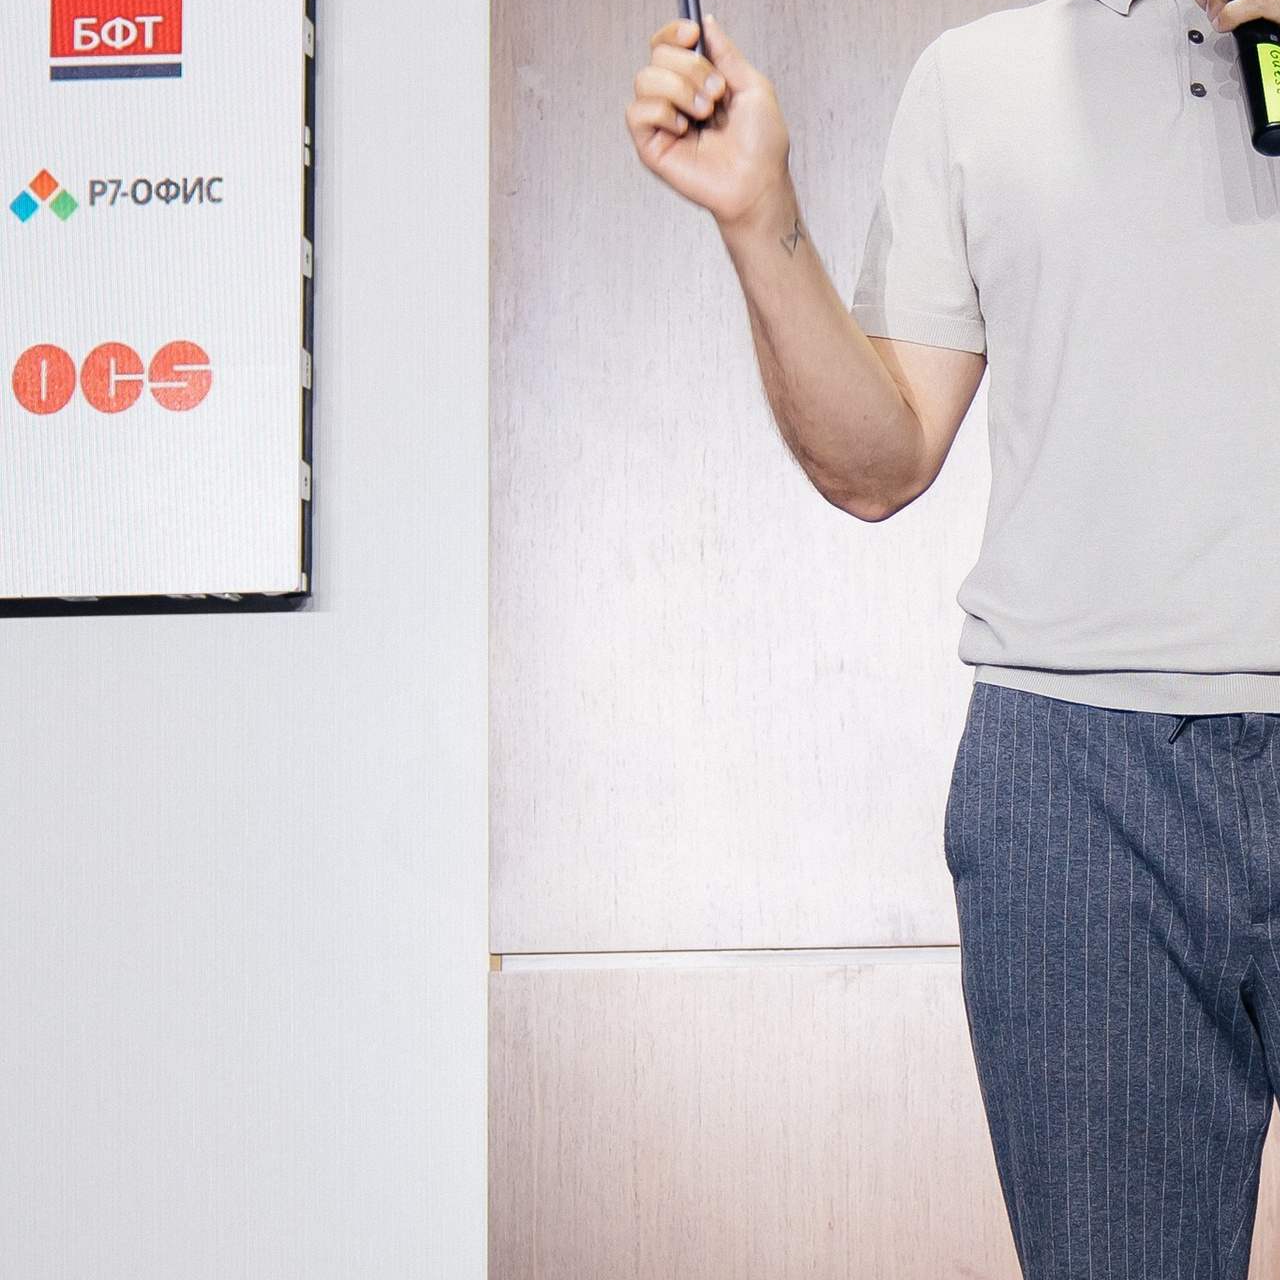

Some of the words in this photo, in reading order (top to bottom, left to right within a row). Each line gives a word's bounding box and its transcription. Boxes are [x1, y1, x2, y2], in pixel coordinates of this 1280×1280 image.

[73, 16, 163, 51] БФТ
[89, 176, 223, 207] Р7-ОФИС
[12, 340, 213, 415] OCS
